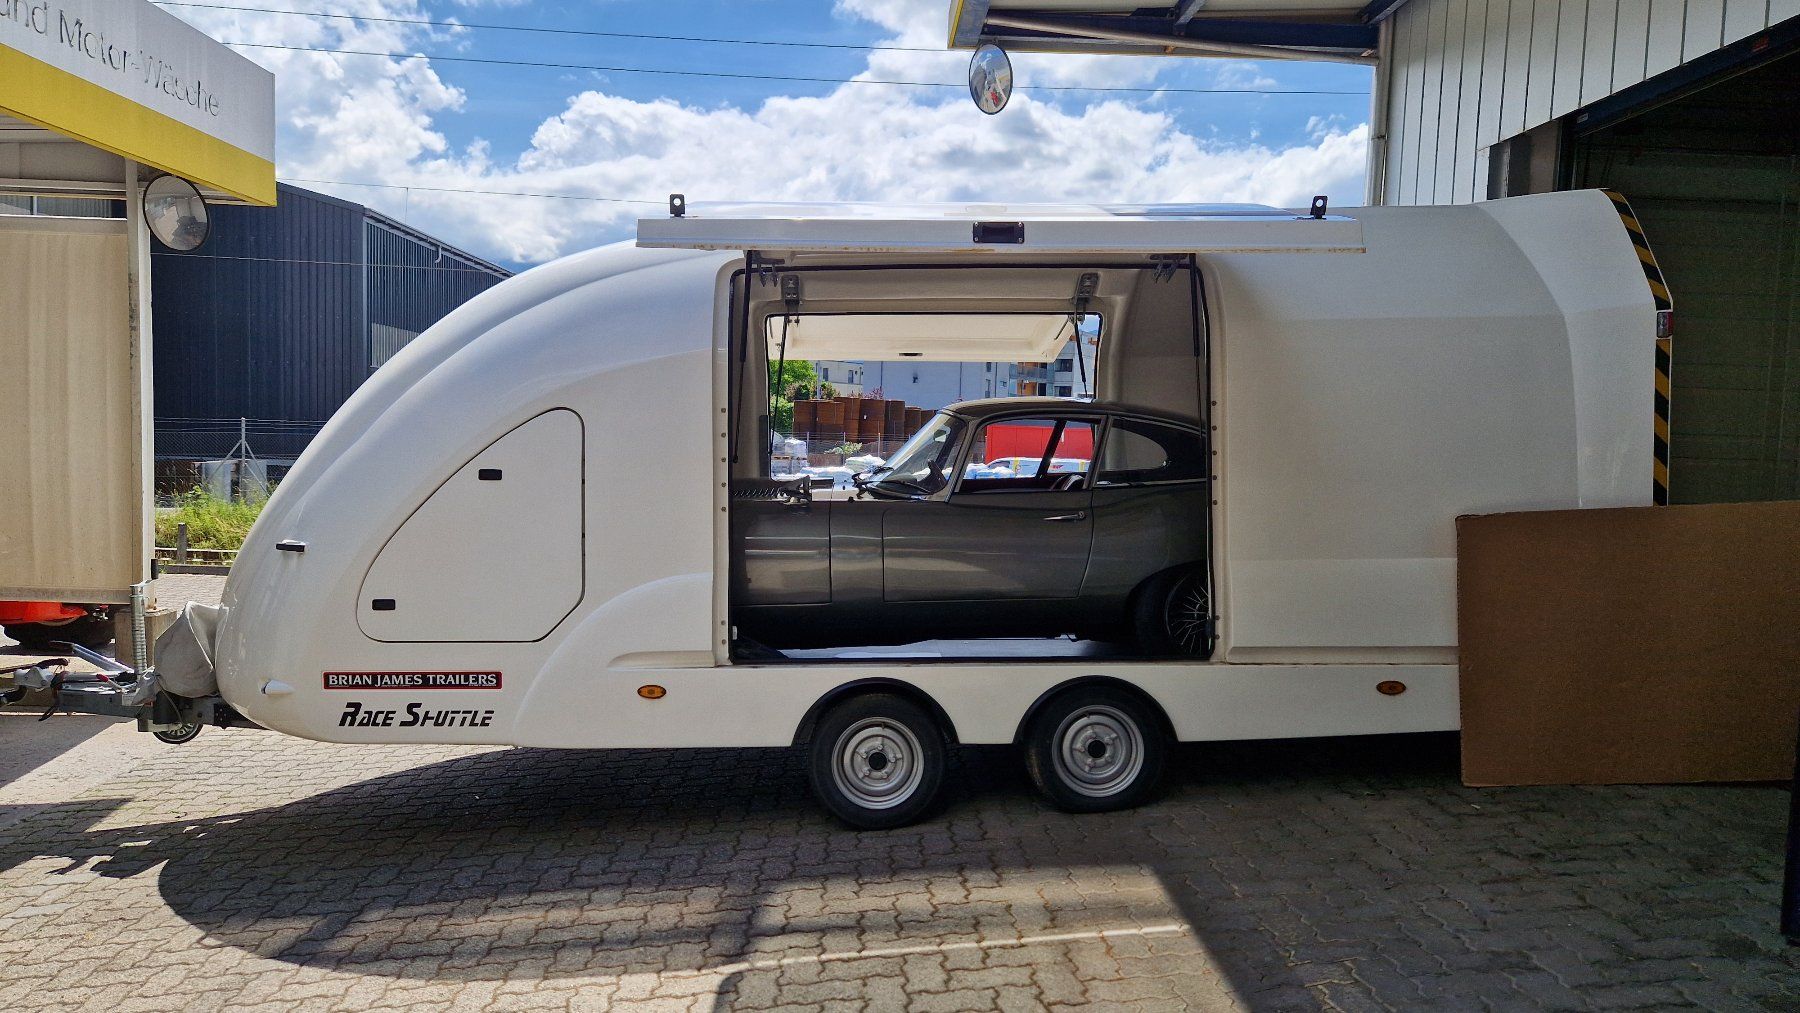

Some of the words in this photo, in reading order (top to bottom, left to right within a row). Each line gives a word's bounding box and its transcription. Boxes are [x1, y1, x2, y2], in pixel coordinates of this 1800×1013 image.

[328, 674, 372, 686] BRIAN
[375, 674, 423, 687] JAMES
[427, 673, 497, 686] TRAILERS
